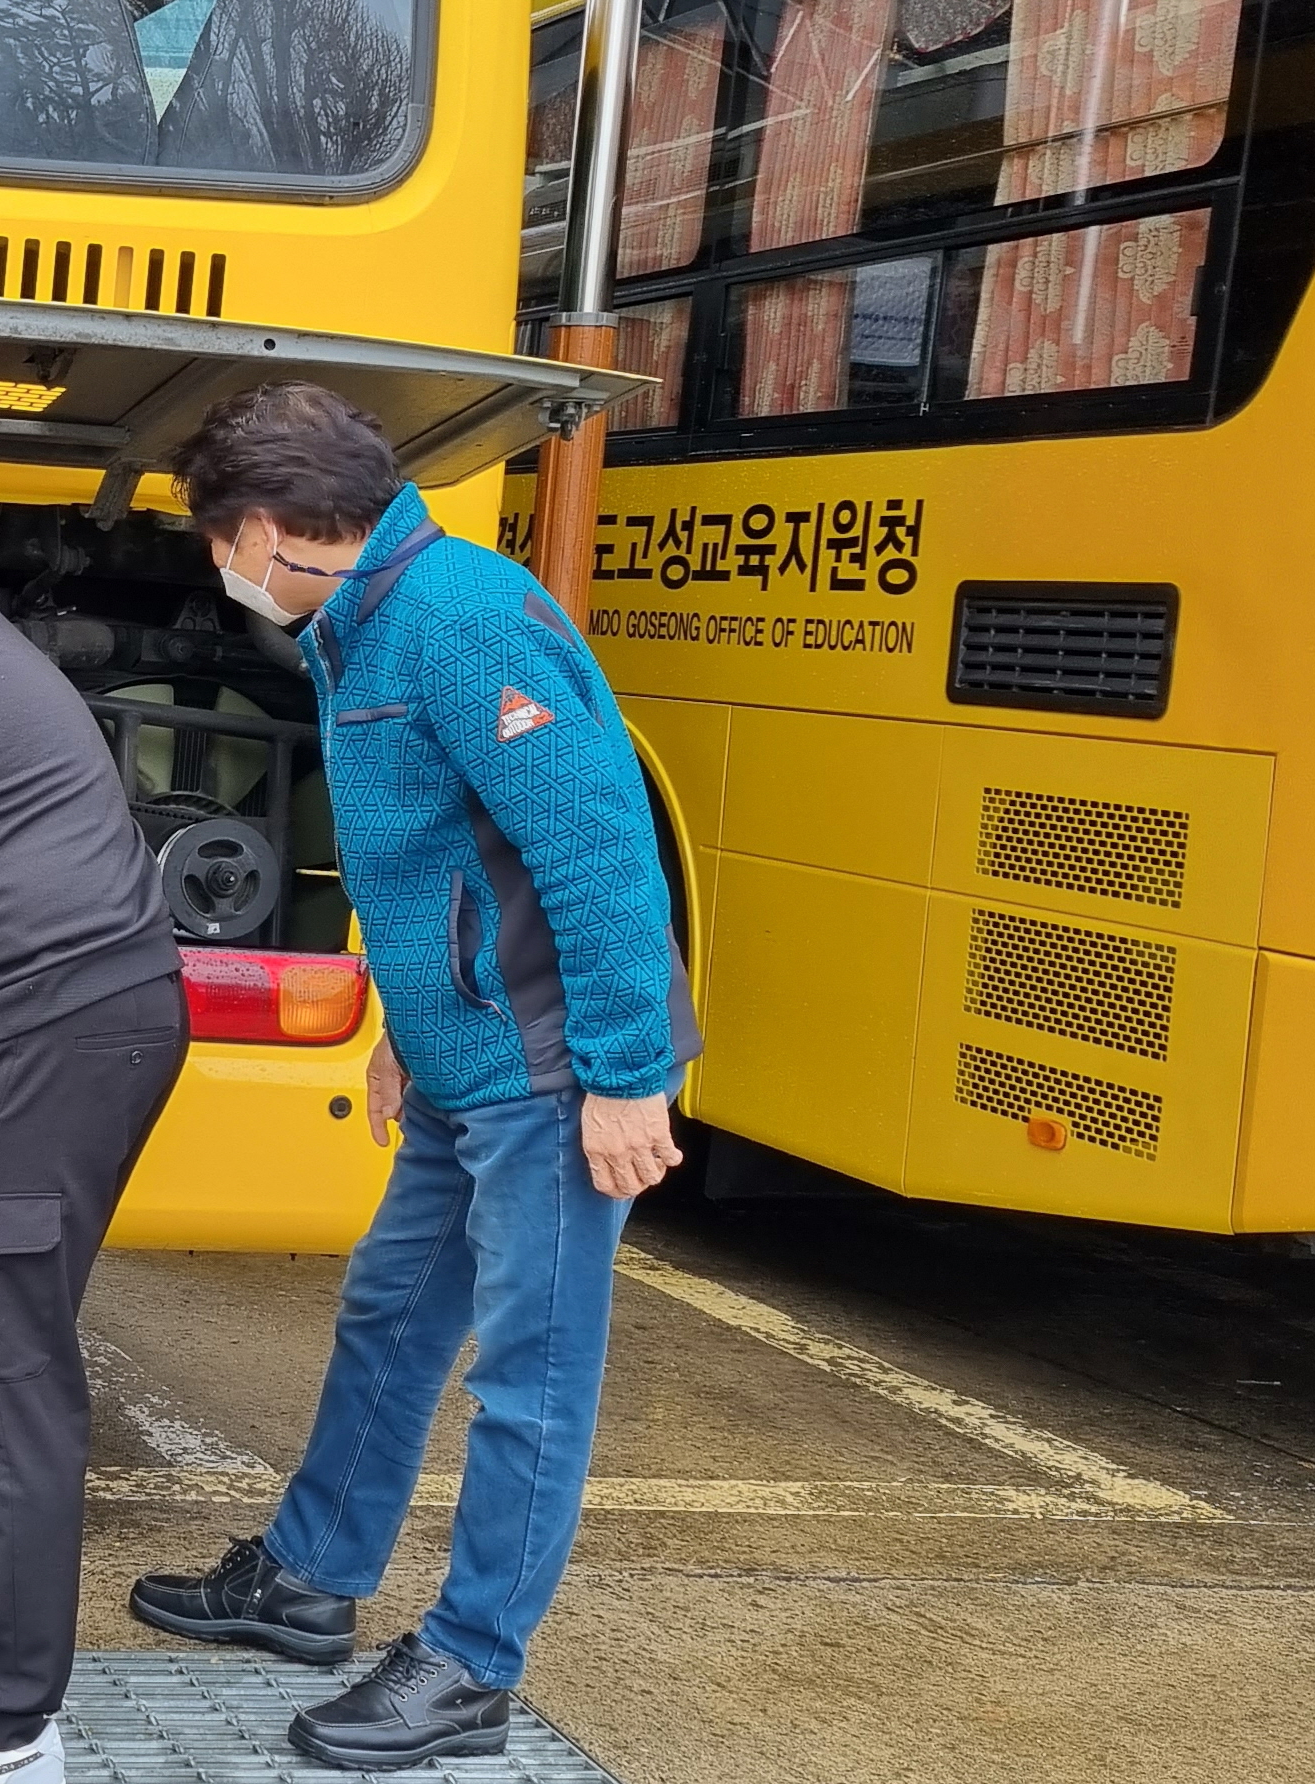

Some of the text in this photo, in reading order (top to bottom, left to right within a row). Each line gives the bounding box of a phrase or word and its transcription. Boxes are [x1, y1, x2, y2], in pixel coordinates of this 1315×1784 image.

[588, 608, 915, 654] MDO GOSEONG OFFICE OF EDUCATION
